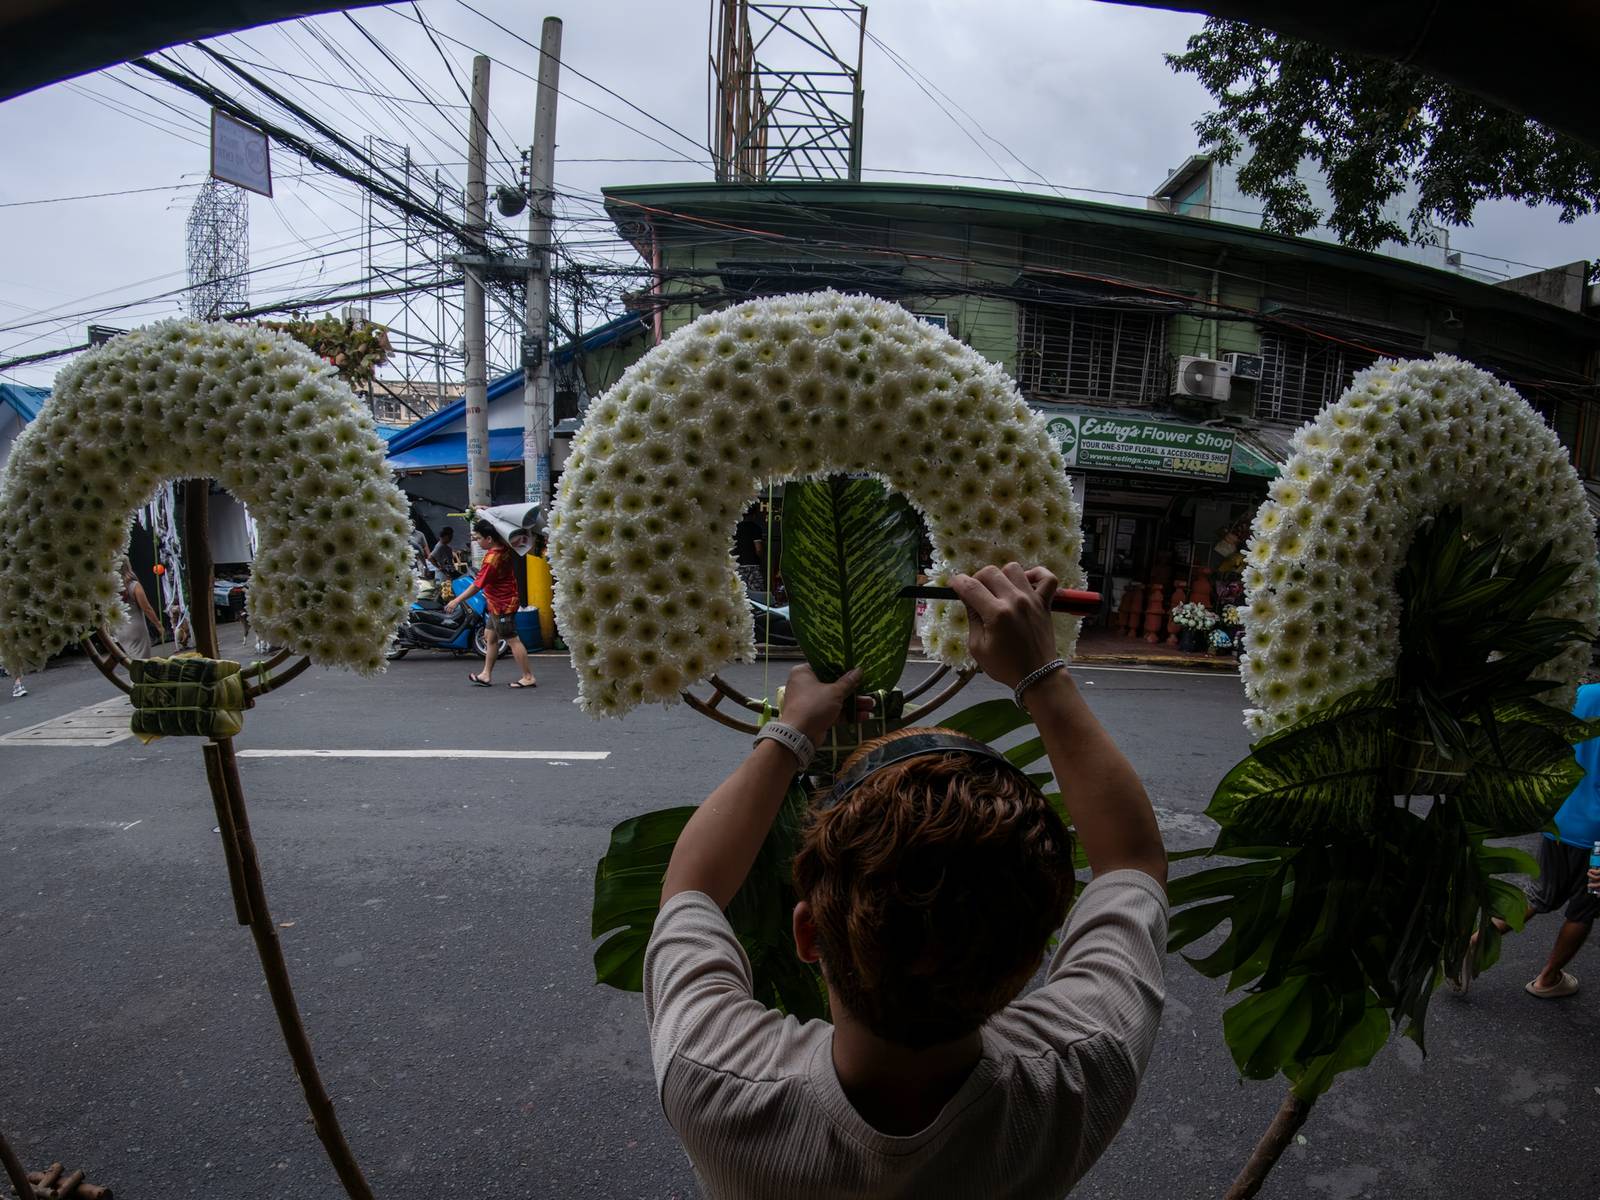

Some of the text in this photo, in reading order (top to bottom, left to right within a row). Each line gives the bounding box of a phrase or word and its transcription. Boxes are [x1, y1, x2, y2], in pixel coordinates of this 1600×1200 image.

[1081, 418, 1233, 451] Esting's Flower Shop
[1081, 441, 1228, 462] YOUR ONE-STOP FLORAL & ACCESSORIES SHOP
[1089, 453, 1161, 466] www.estings.com
